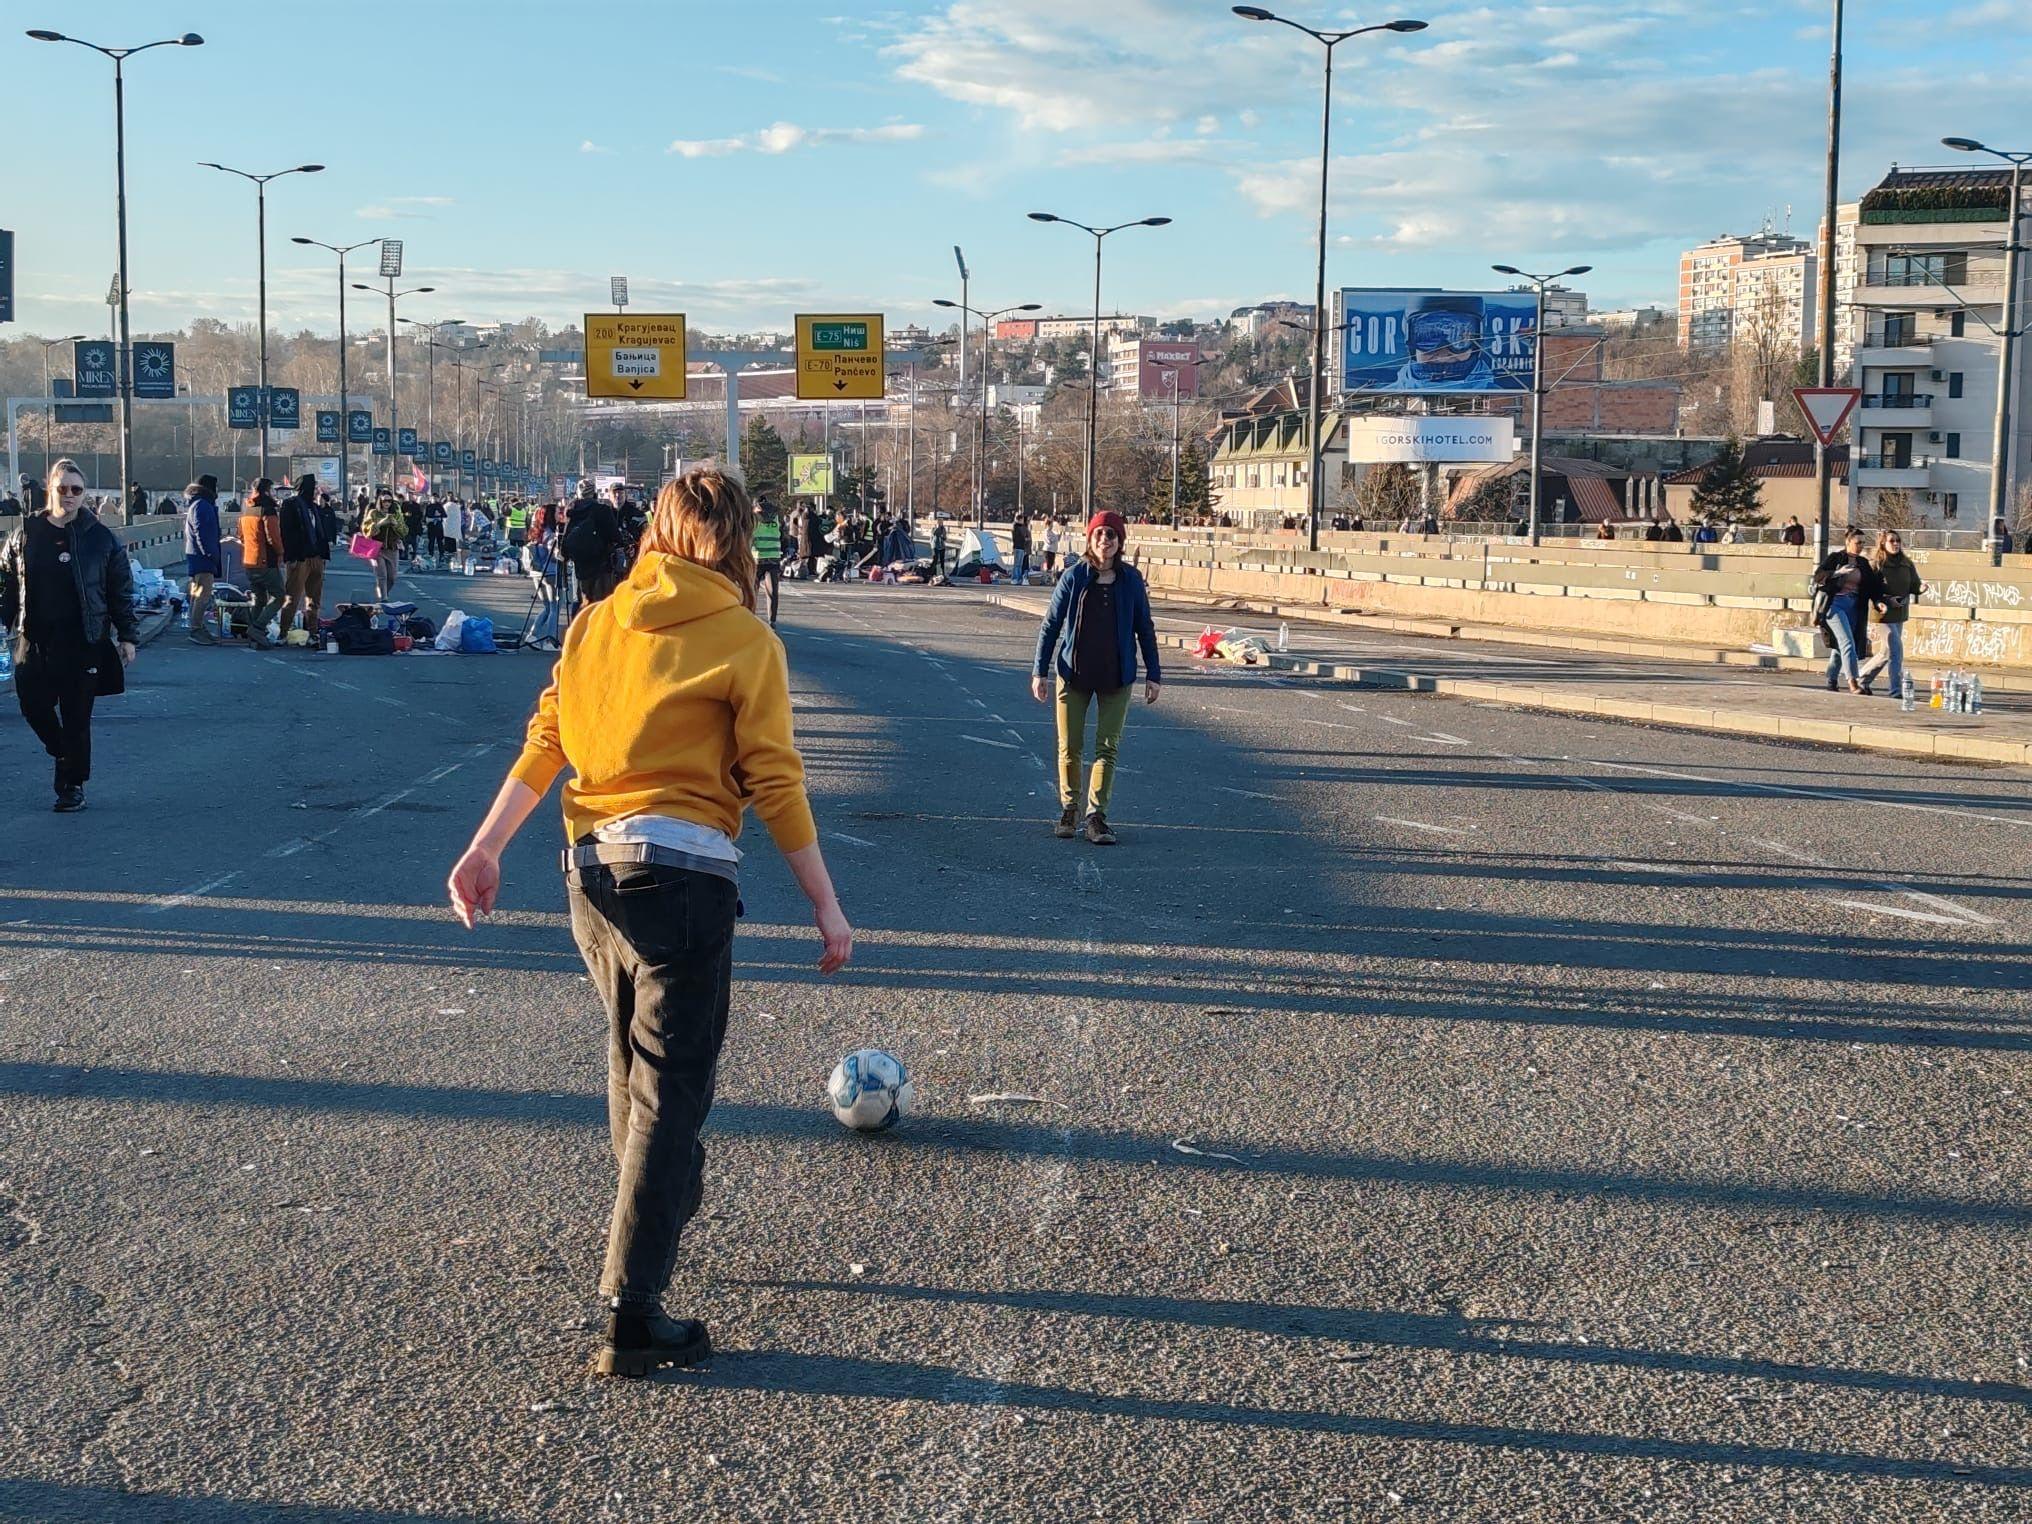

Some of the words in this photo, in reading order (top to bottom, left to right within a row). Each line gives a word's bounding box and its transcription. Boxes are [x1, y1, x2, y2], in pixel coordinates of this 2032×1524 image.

[595, 328, 614, 339] 200
[617, 322, 676, 334] Крагујевац
[843, 325, 865, 335] Ниш
[618, 335, 676, 346] Kragujevac
[816, 331, 840, 341] E-75
[615, 351, 657, 362] Бањица
[834, 354, 878, 364] Панчево
[617, 364, 656, 375] Banjica
[807, 360, 830, 370] E-70
[78, 370, 116, 384] MIREN
